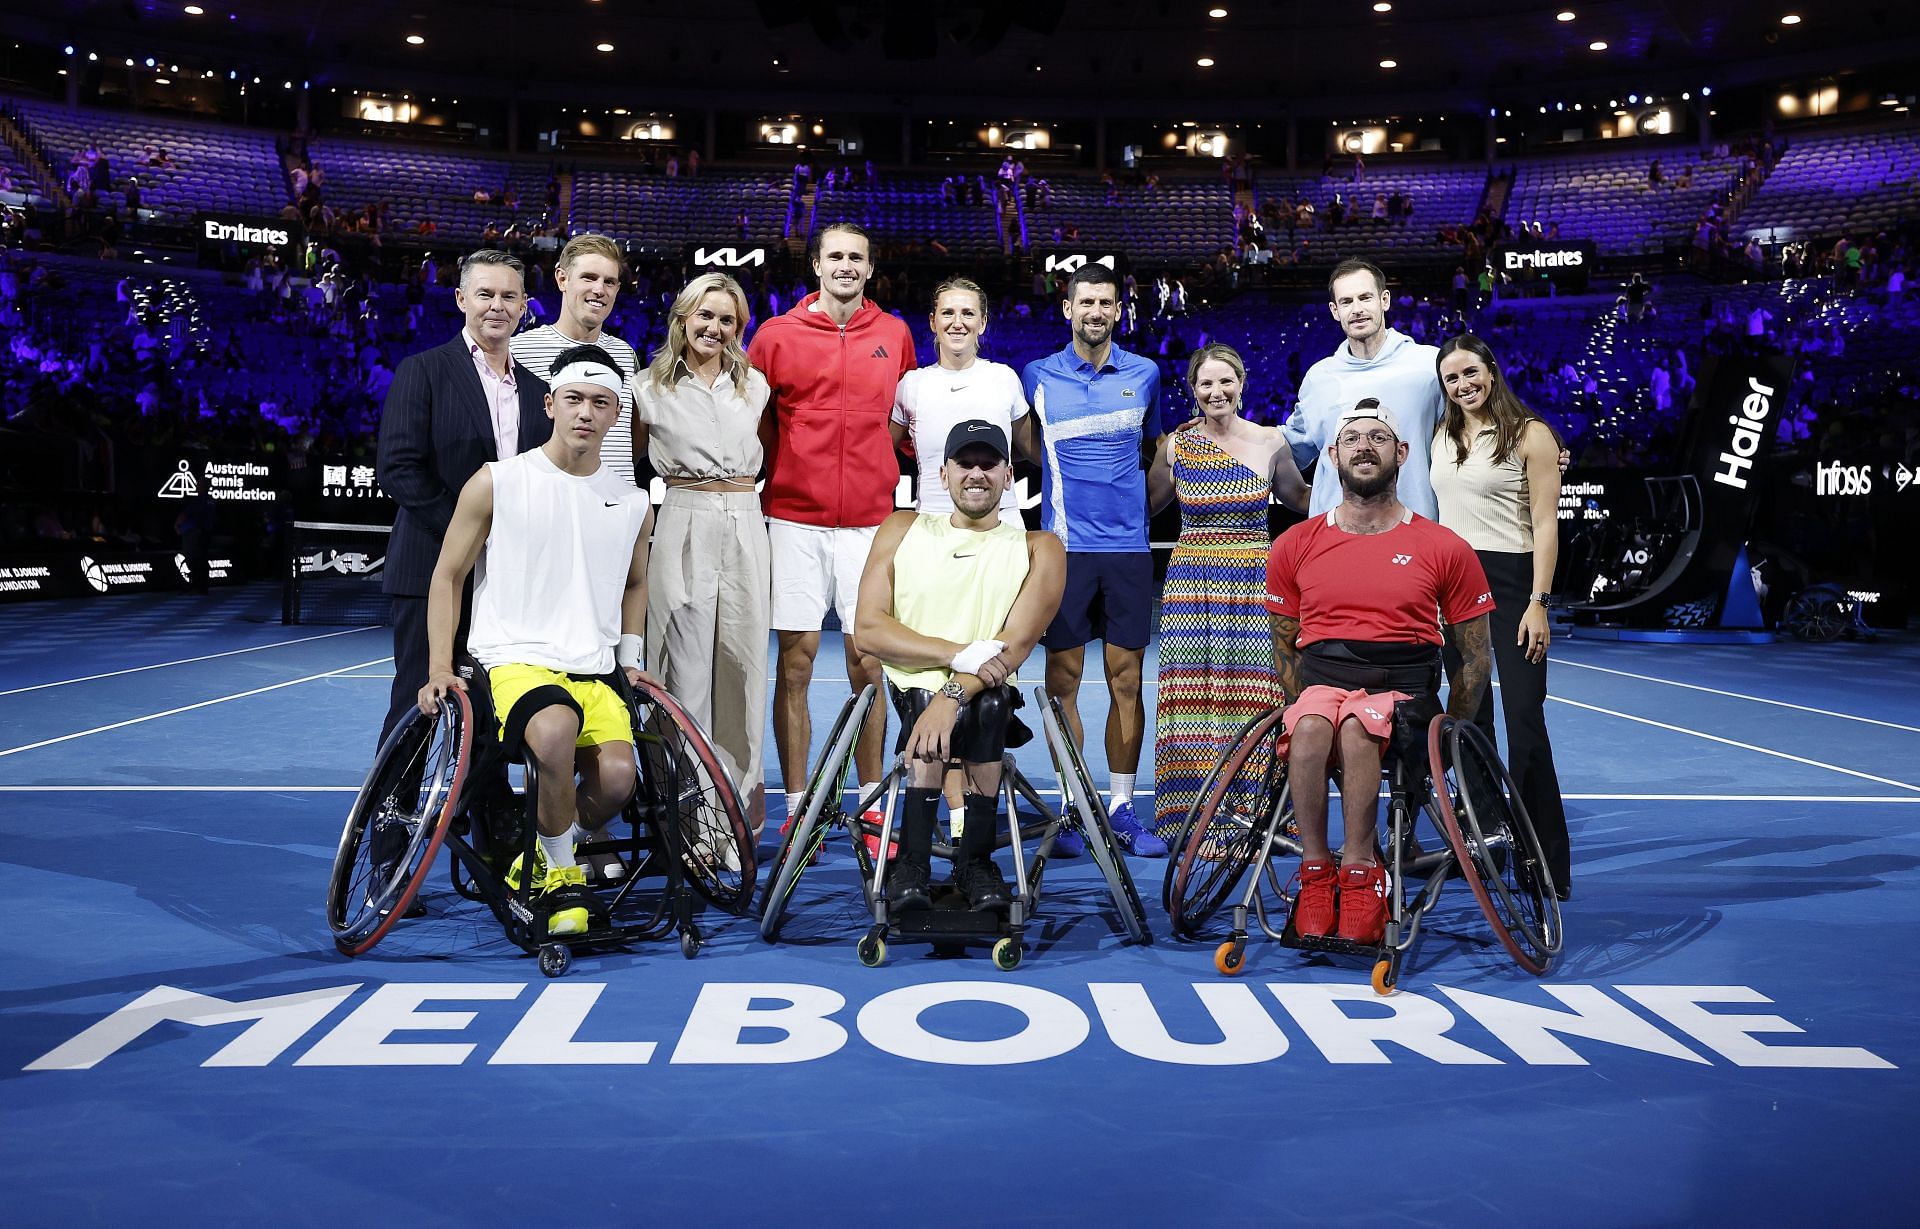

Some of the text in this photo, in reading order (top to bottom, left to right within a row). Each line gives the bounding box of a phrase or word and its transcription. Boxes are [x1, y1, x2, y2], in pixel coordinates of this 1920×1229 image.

[205, 221, 289, 245] Emirates
[694, 247, 765, 267] KIA
[1504, 249, 1583, 269] Emirates
[1713, 376, 1775, 490] Haier
[204, 461, 269, 476] Australian
[1816, 459, 1872, 496] Infosys
[207, 487, 276, 501] oundation
[1561, 481, 1605, 496] stralian
[1558, 494, 1582, 508] nnis
[1621, 549, 1649, 565] AO
[0, 580, 41, 591] OUNDATION
[23, 981, 1898, 1070] MELBOURNE
